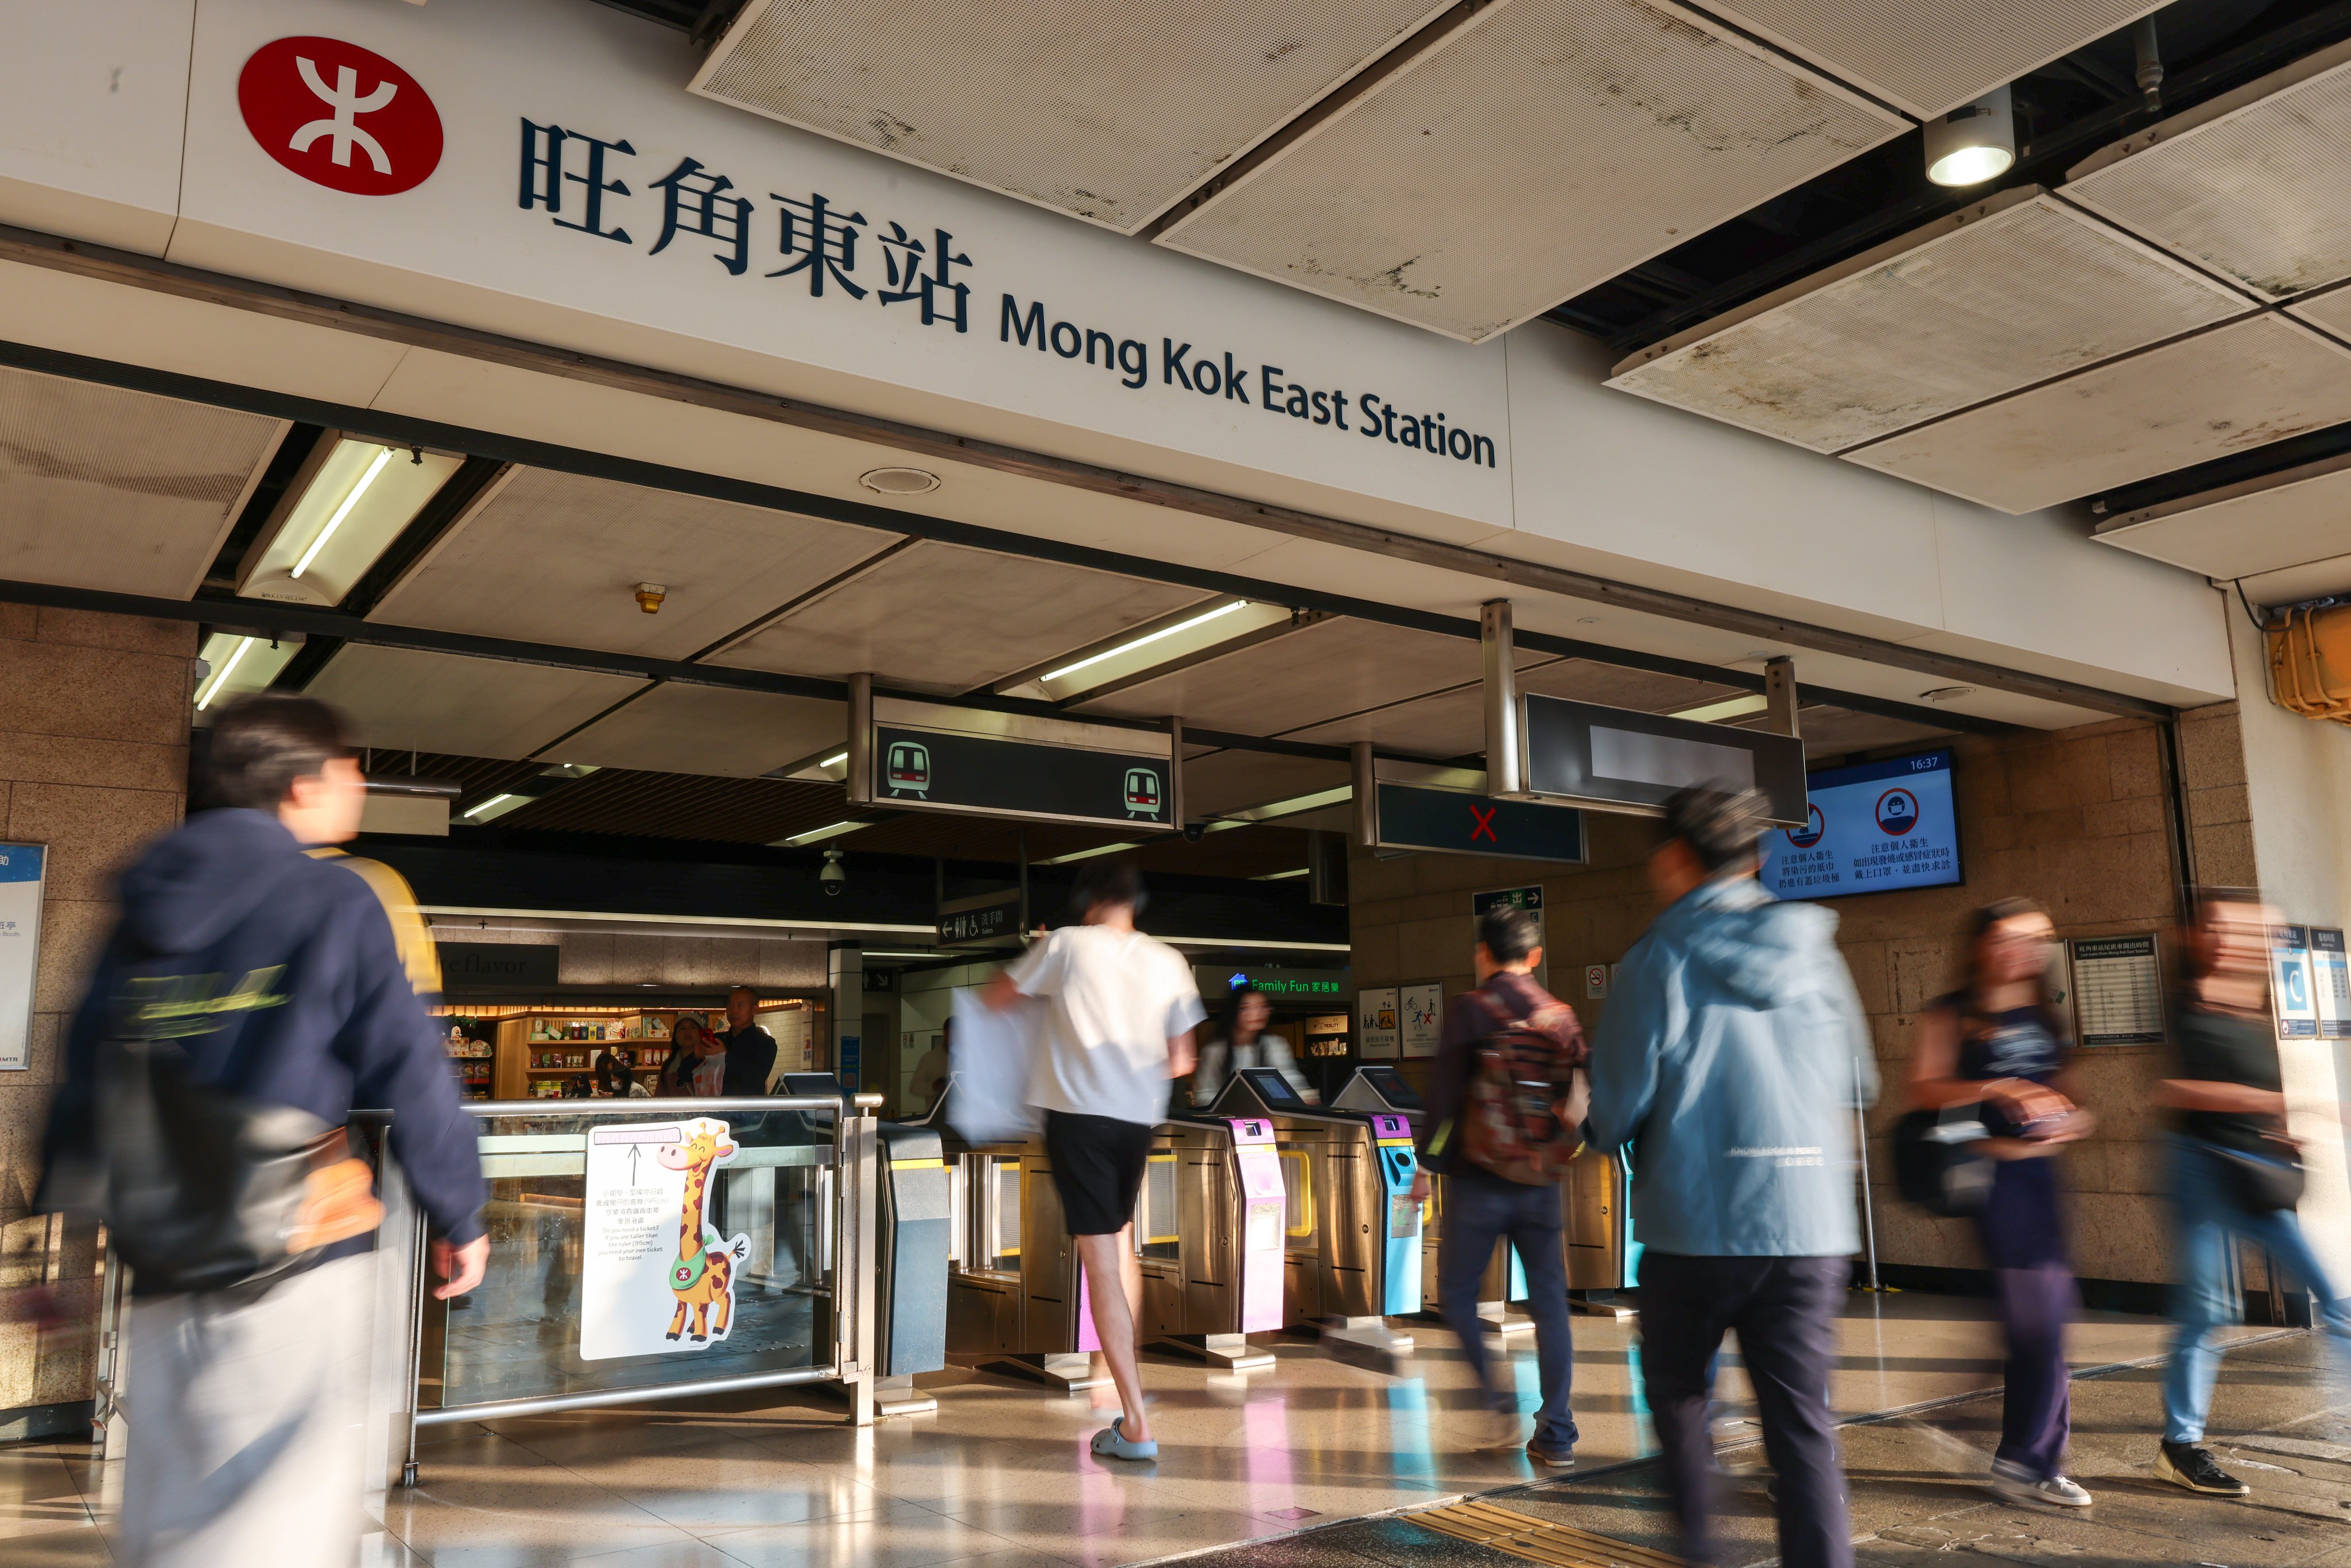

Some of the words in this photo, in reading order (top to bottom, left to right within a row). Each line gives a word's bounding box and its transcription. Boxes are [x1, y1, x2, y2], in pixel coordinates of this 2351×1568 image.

[519, 117, 973, 333] 旺角東站
[1000, 293, 1148, 389] Mong
[1163, 337, 1250, 405] Kok
[1262, 364, 1349, 431] East
[1360, 393, 1496, 468] Station
[1910, 757, 1938, 770] 16:37
[1512, 892, 1522, 903] 出
[465, 952, 527, 974] flavor
[1252, 979, 1287, 994] Family
[1290, 980, 1309, 992] Fun
[1312, 981, 1340, 993] 家居樂
[2290, 970, 2302, 1003] C
